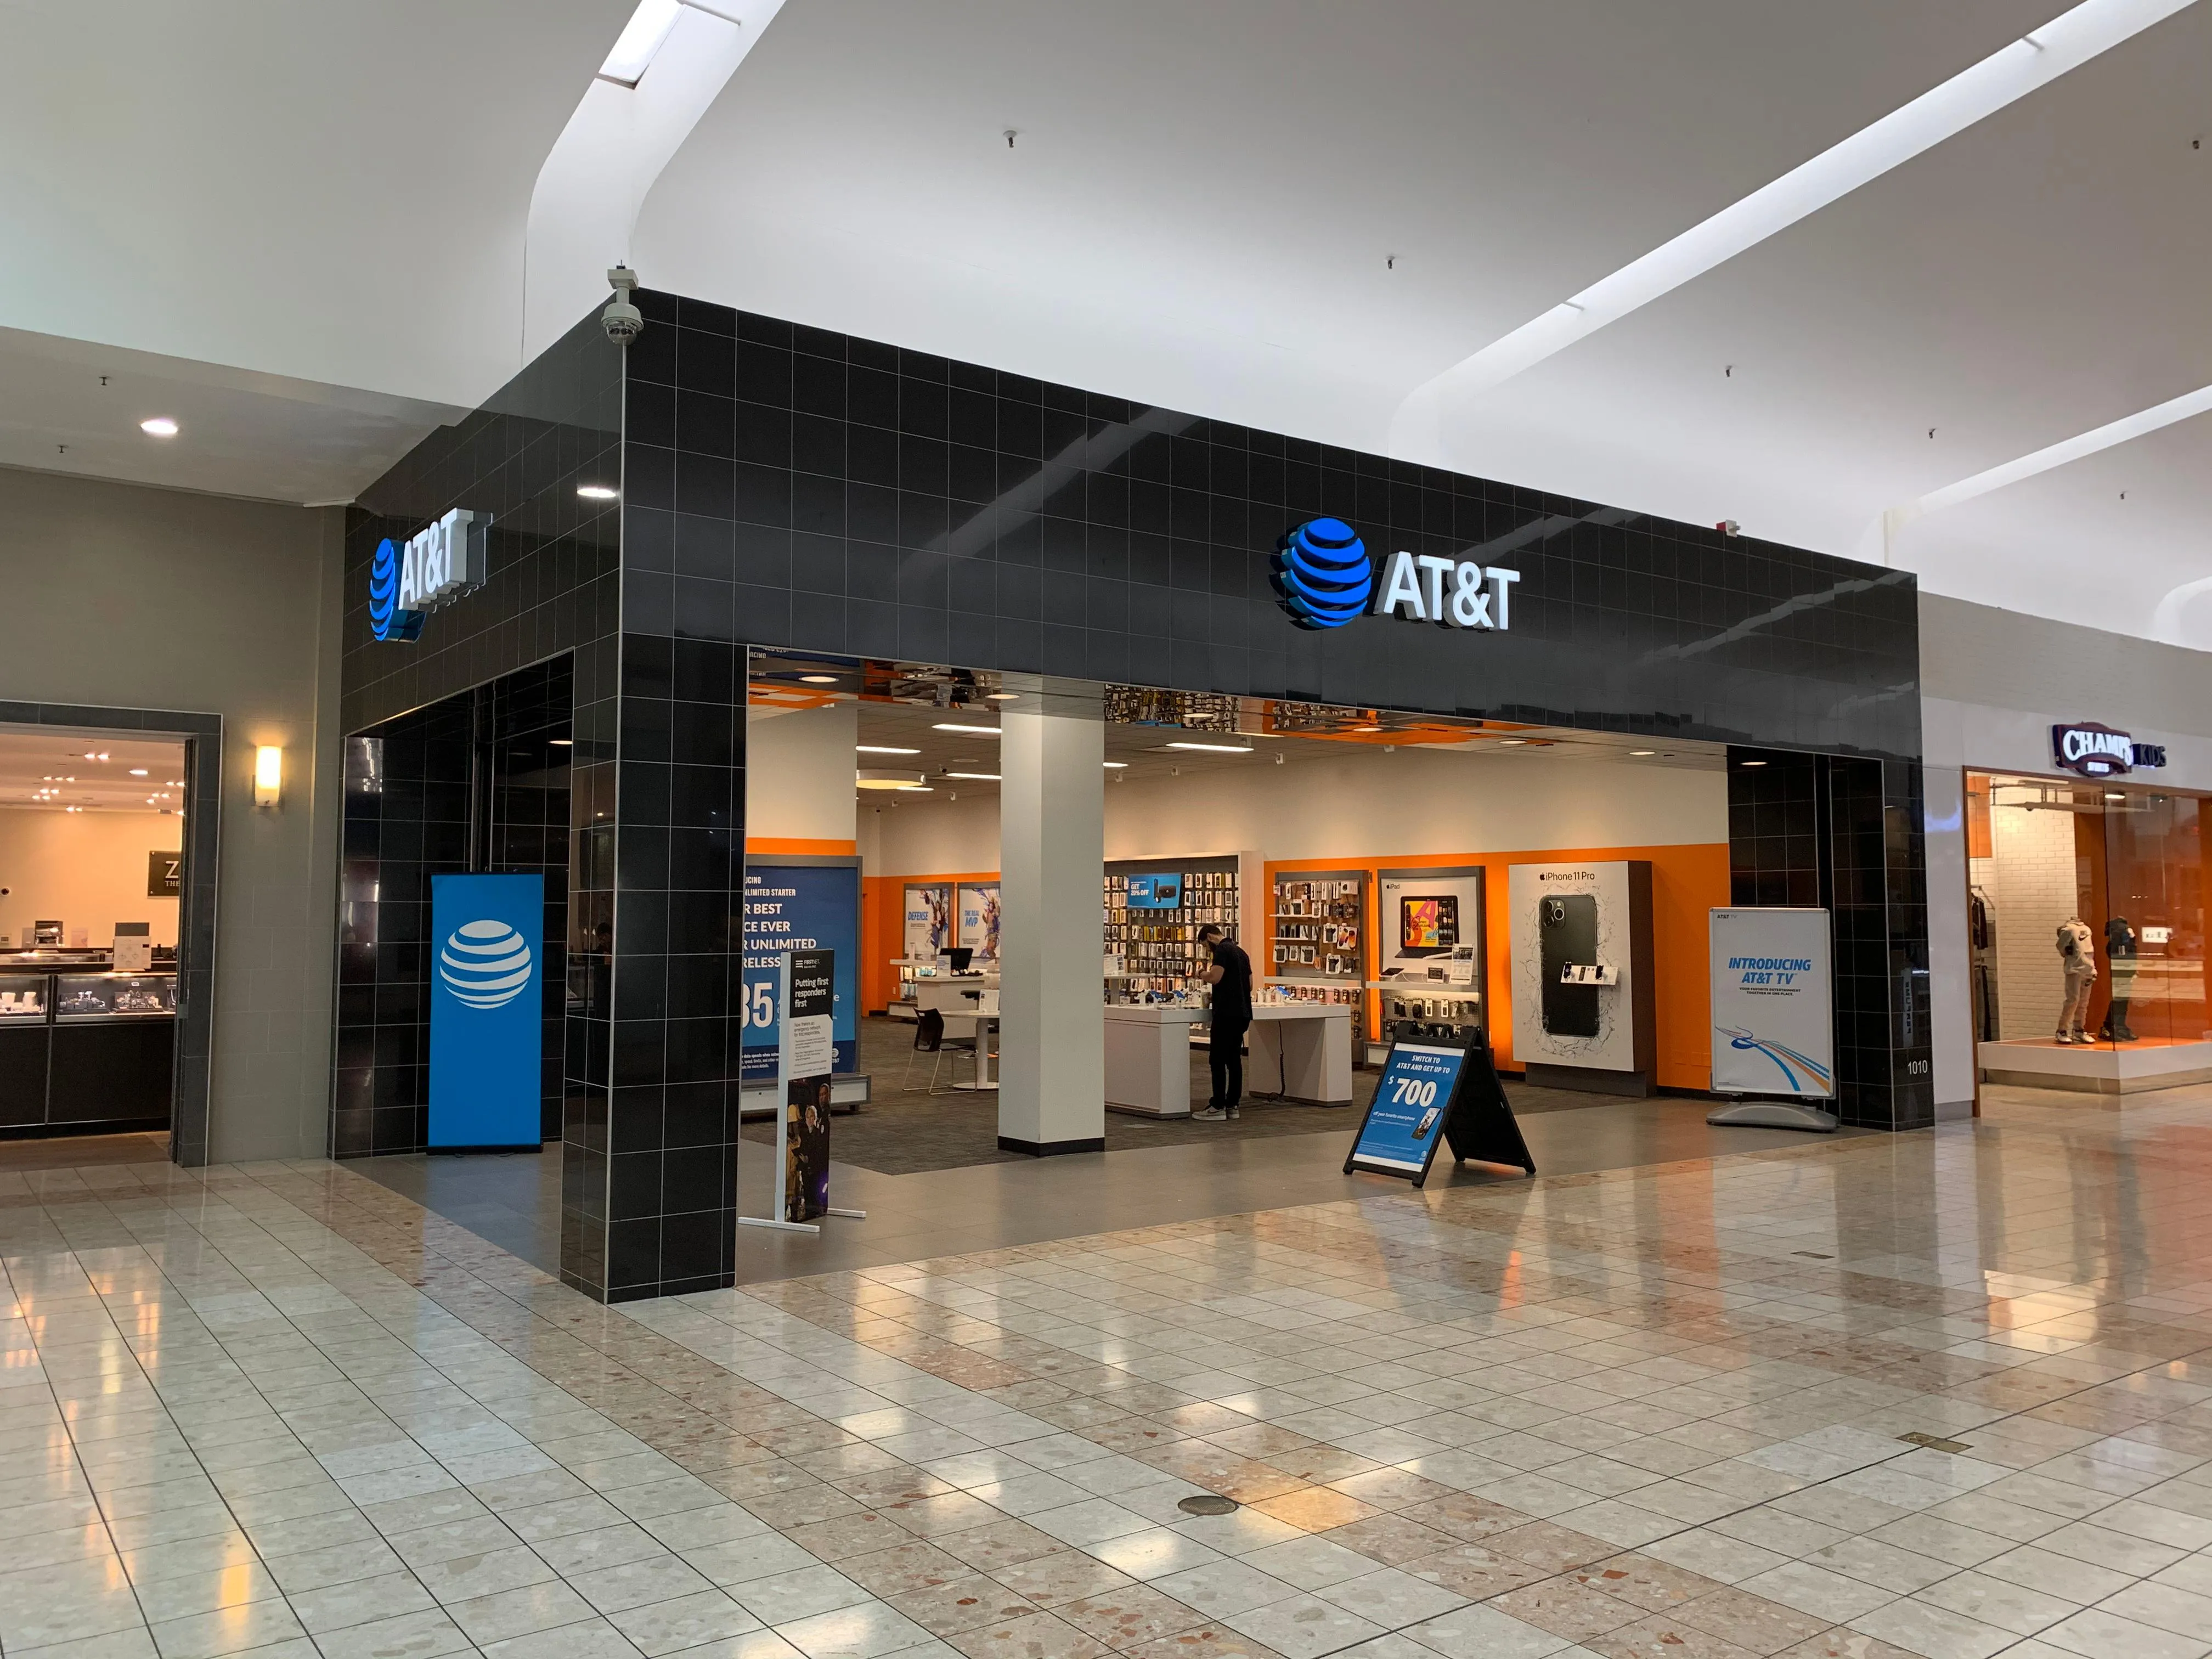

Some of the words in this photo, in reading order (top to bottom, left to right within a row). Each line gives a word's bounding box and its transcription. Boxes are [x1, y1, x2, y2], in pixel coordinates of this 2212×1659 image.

[399, 507, 458, 610] AT&T
[1383, 551, 1520, 630] AT&T
[2063, 730, 2132, 766] CHAMPS
[2140, 744, 2166, 767] KIDS
[1546, 872, 1572, 881] iPhone
[1573, 872, 1580, 880] 11
[1582, 871, 1595, 880] Pro
[771, 888, 796, 896] STARTER
[753, 903, 783, 915] BEST
[908, 911, 929, 921] DEFENSE
[761, 921, 791, 932] EVER
[965, 917, 978, 927] MVP
[751, 938, 817, 950] UNLIMITED
[1729, 957, 1812, 970] INTRODUCING
[795, 978, 816, 988] Putting
[817, 977, 829, 986] first
[1741, 972, 1773, 984] AT&T
[795, 987, 827, 998] responders
[794, 999, 807, 1008] first
[1412, 1055, 1432, 1063] SWITCH
[1908, 1060, 1928, 1075] 1010
